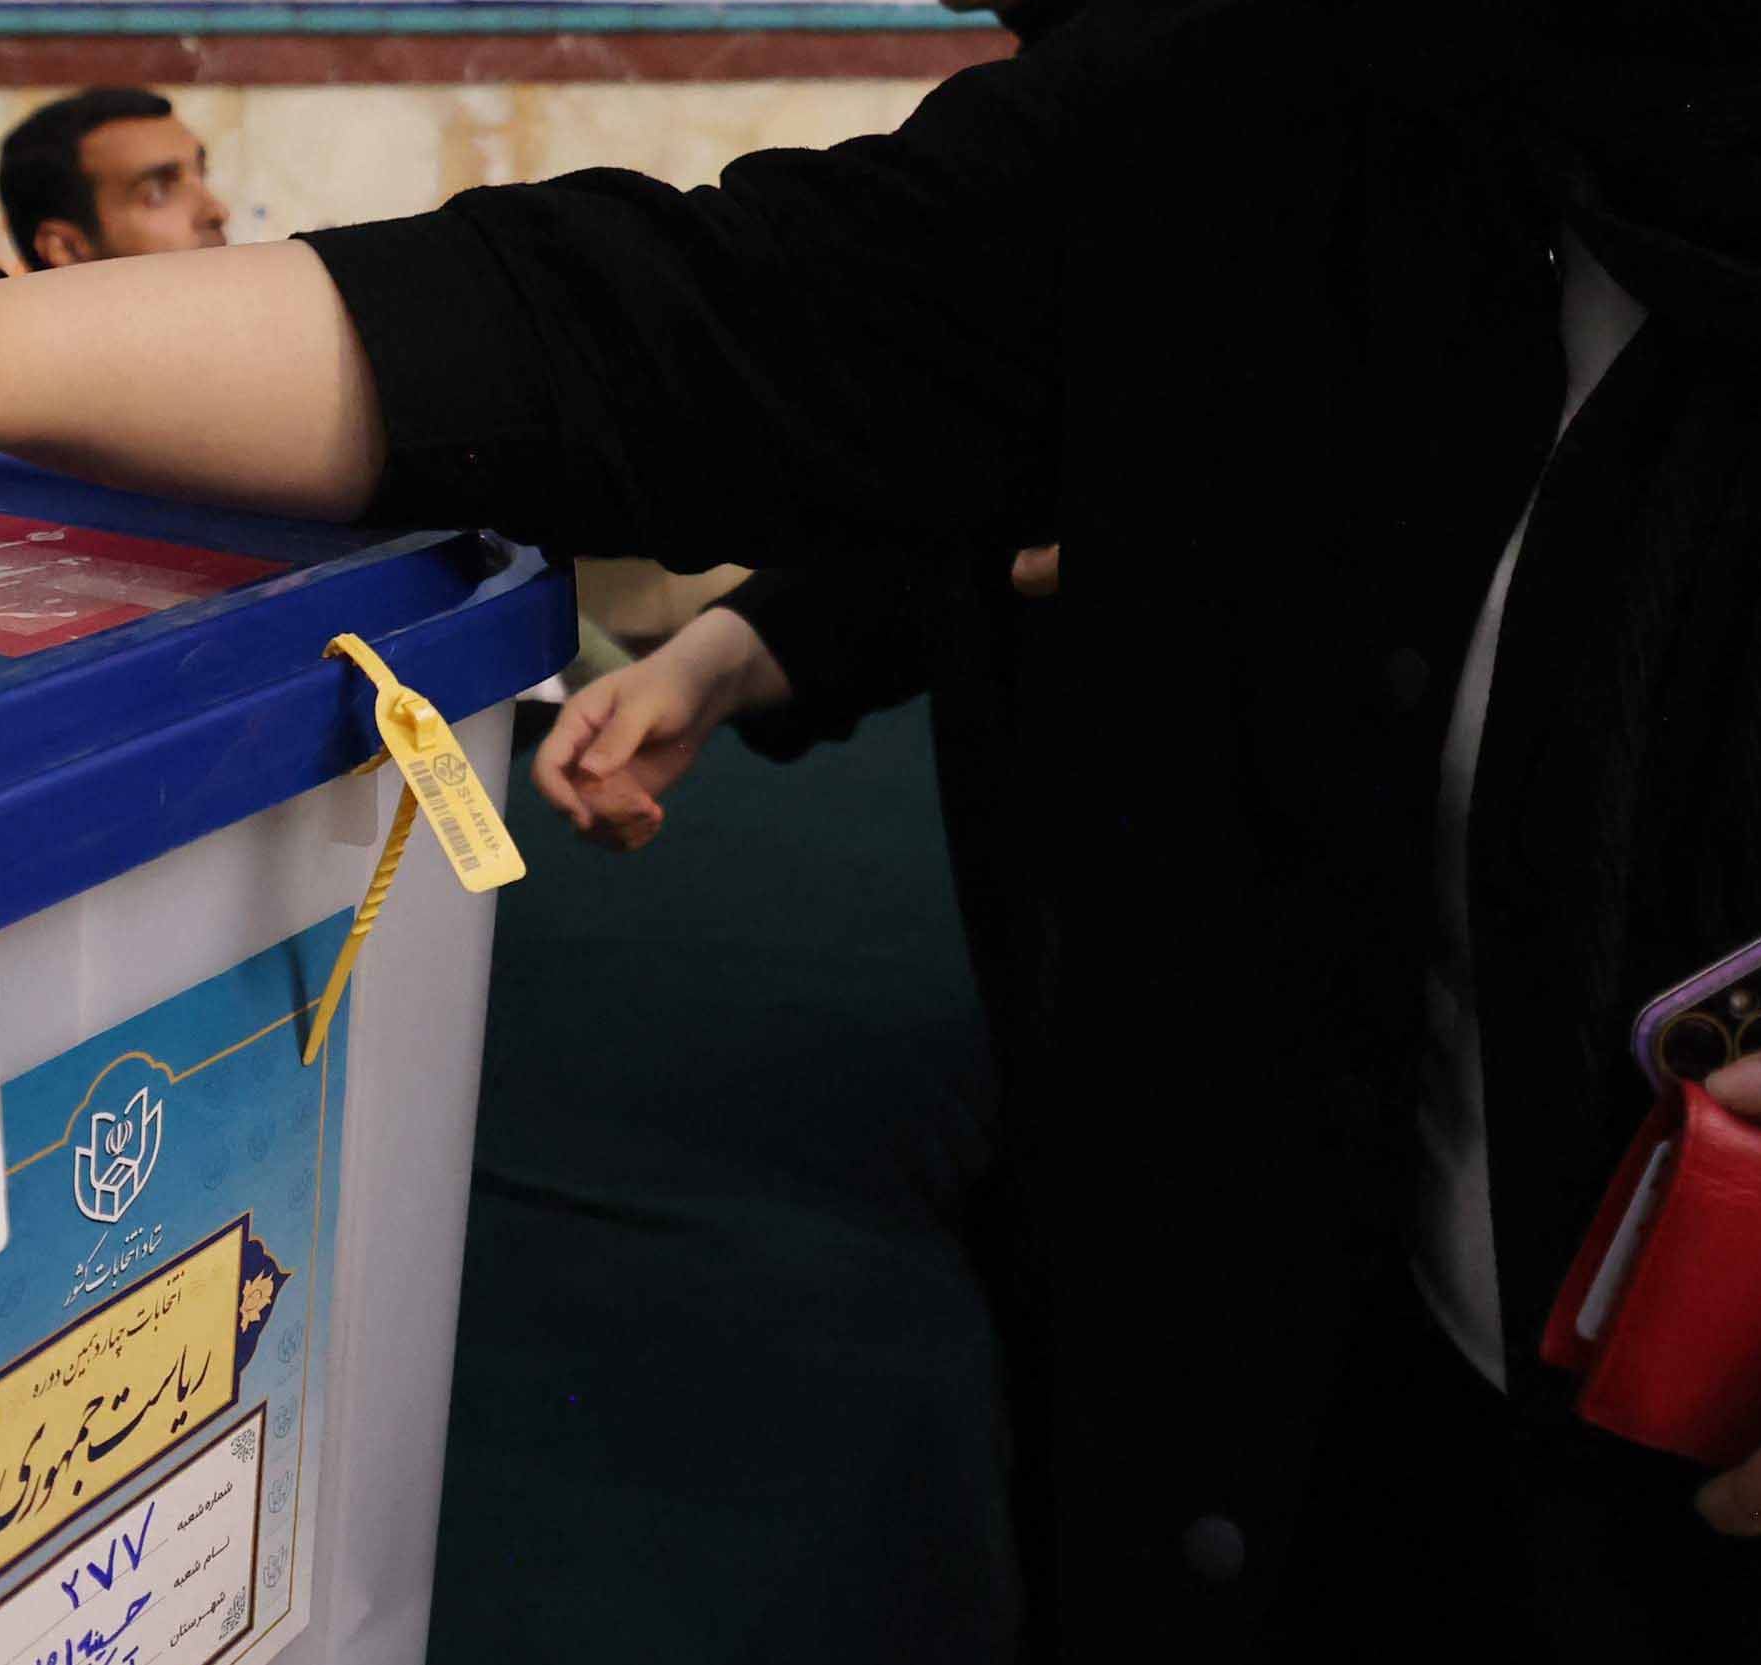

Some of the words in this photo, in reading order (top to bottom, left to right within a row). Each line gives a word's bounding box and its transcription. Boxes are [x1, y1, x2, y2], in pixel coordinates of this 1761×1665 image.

[86, 1226, 144, 1294] انتخابات
[126, 1269, 186, 1337] انتخابات
[32, 1367, 61, 1398] دوره
[62, 1327, 126, 1387] چهاردهمین
[87, 1343, 211, 1462] ریاست
[176, 1504, 205, 1532] شعبه
[204, 1481, 233, 1511] شماره
[173, 1560, 202, 1588] شعبه
[169, 1591, 226, 1648] شهرستان
